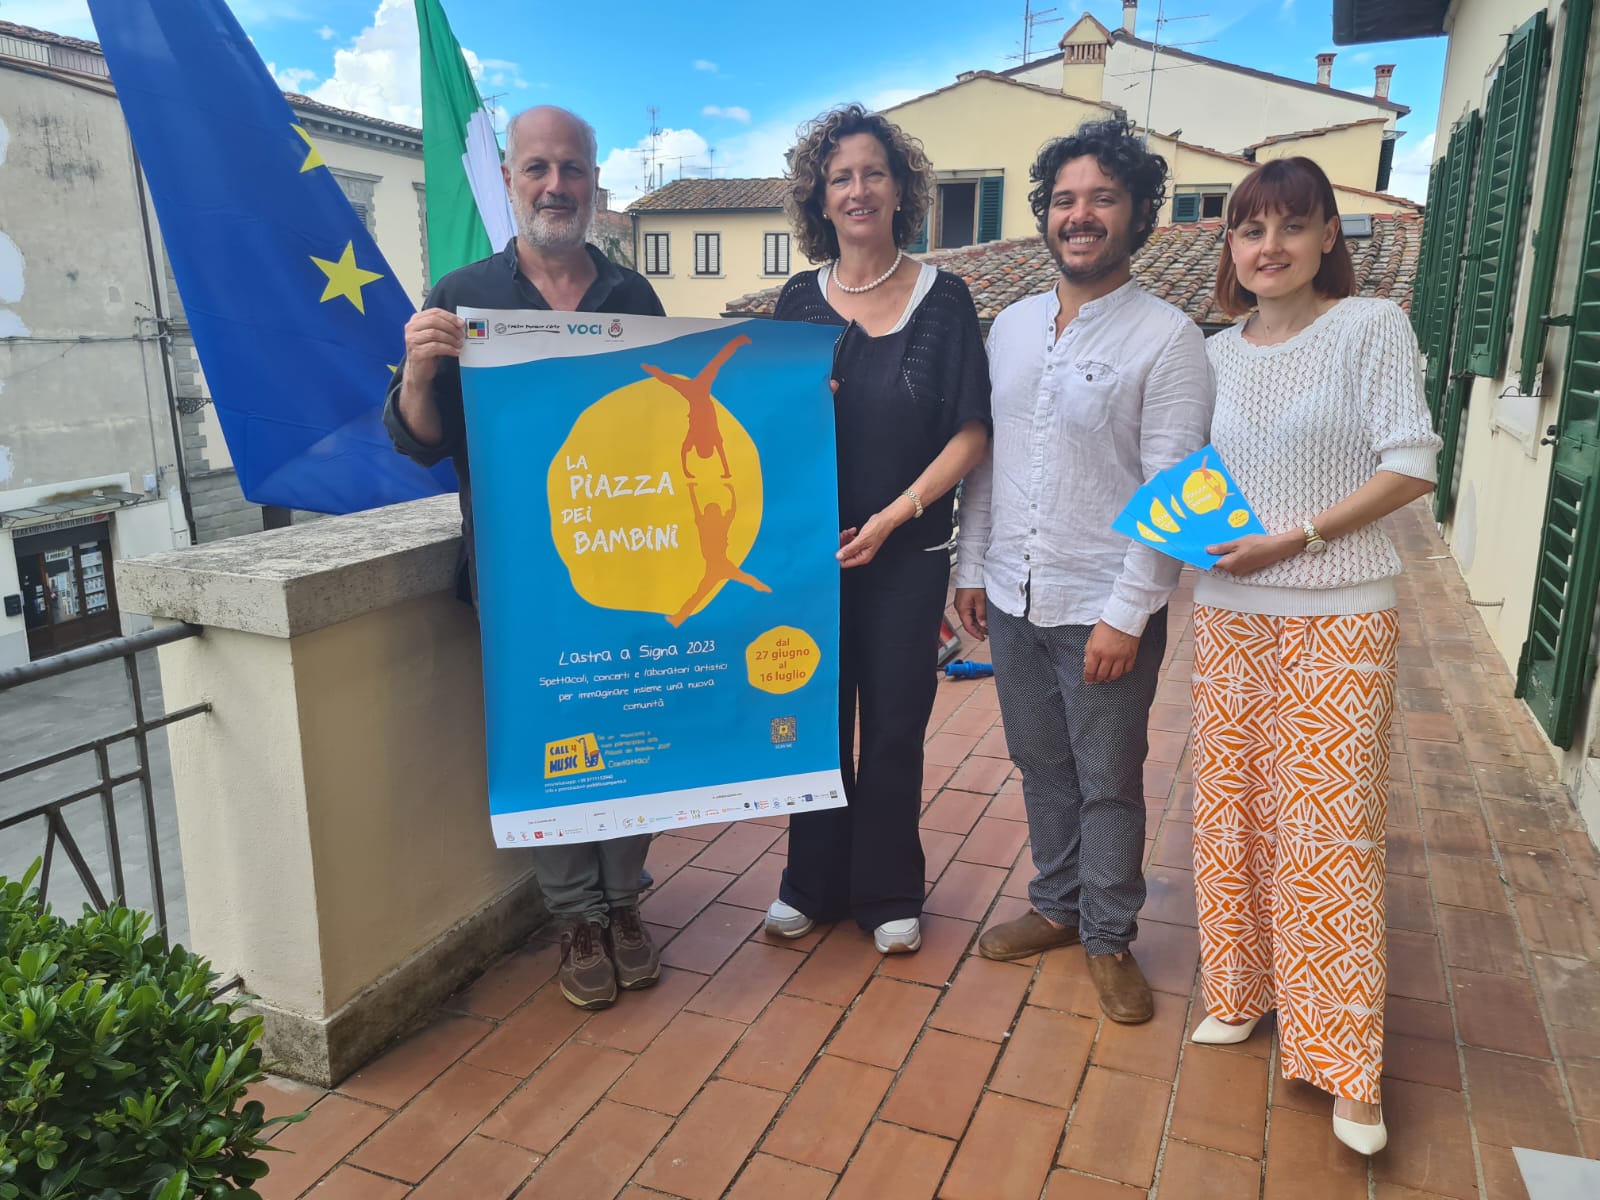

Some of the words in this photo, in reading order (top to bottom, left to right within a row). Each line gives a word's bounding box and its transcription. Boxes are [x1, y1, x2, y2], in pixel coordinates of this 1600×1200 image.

[567, 323, 602, 335] VOCI
[566, 455, 588, 471] LA
[776, 638, 790, 647] dal
[559, 650, 612, 666] Lastra
[620, 648, 631, 660] a
[639, 644, 678, 661] Signa
[686, 640, 715, 655] 2023
[755, 650, 769, 660] 27
[771, 648, 810, 661] giugno
[779, 661, 787, 669] al
[539, 674, 589, 687] Spettacoli,
[594, 672, 630, 682] concerti
[644, 665, 690, 677] laboratori
[694, 663, 728, 672] artistici
[760, 673, 773, 682] 16
[775, 669, 806, 682] luglio
[558, 693, 573, 703] per
[579, 687, 629, 699] immaginare
[633, 684, 662, 694] insieme
[666, 682, 683, 691] una
[688, 679, 715, 689] nuova
[623, 699, 664, 711] comunità
[549, 745, 569, 756] CALL
[571, 744, 577, 753] 4
[549, 755, 578, 773] MUSIC
